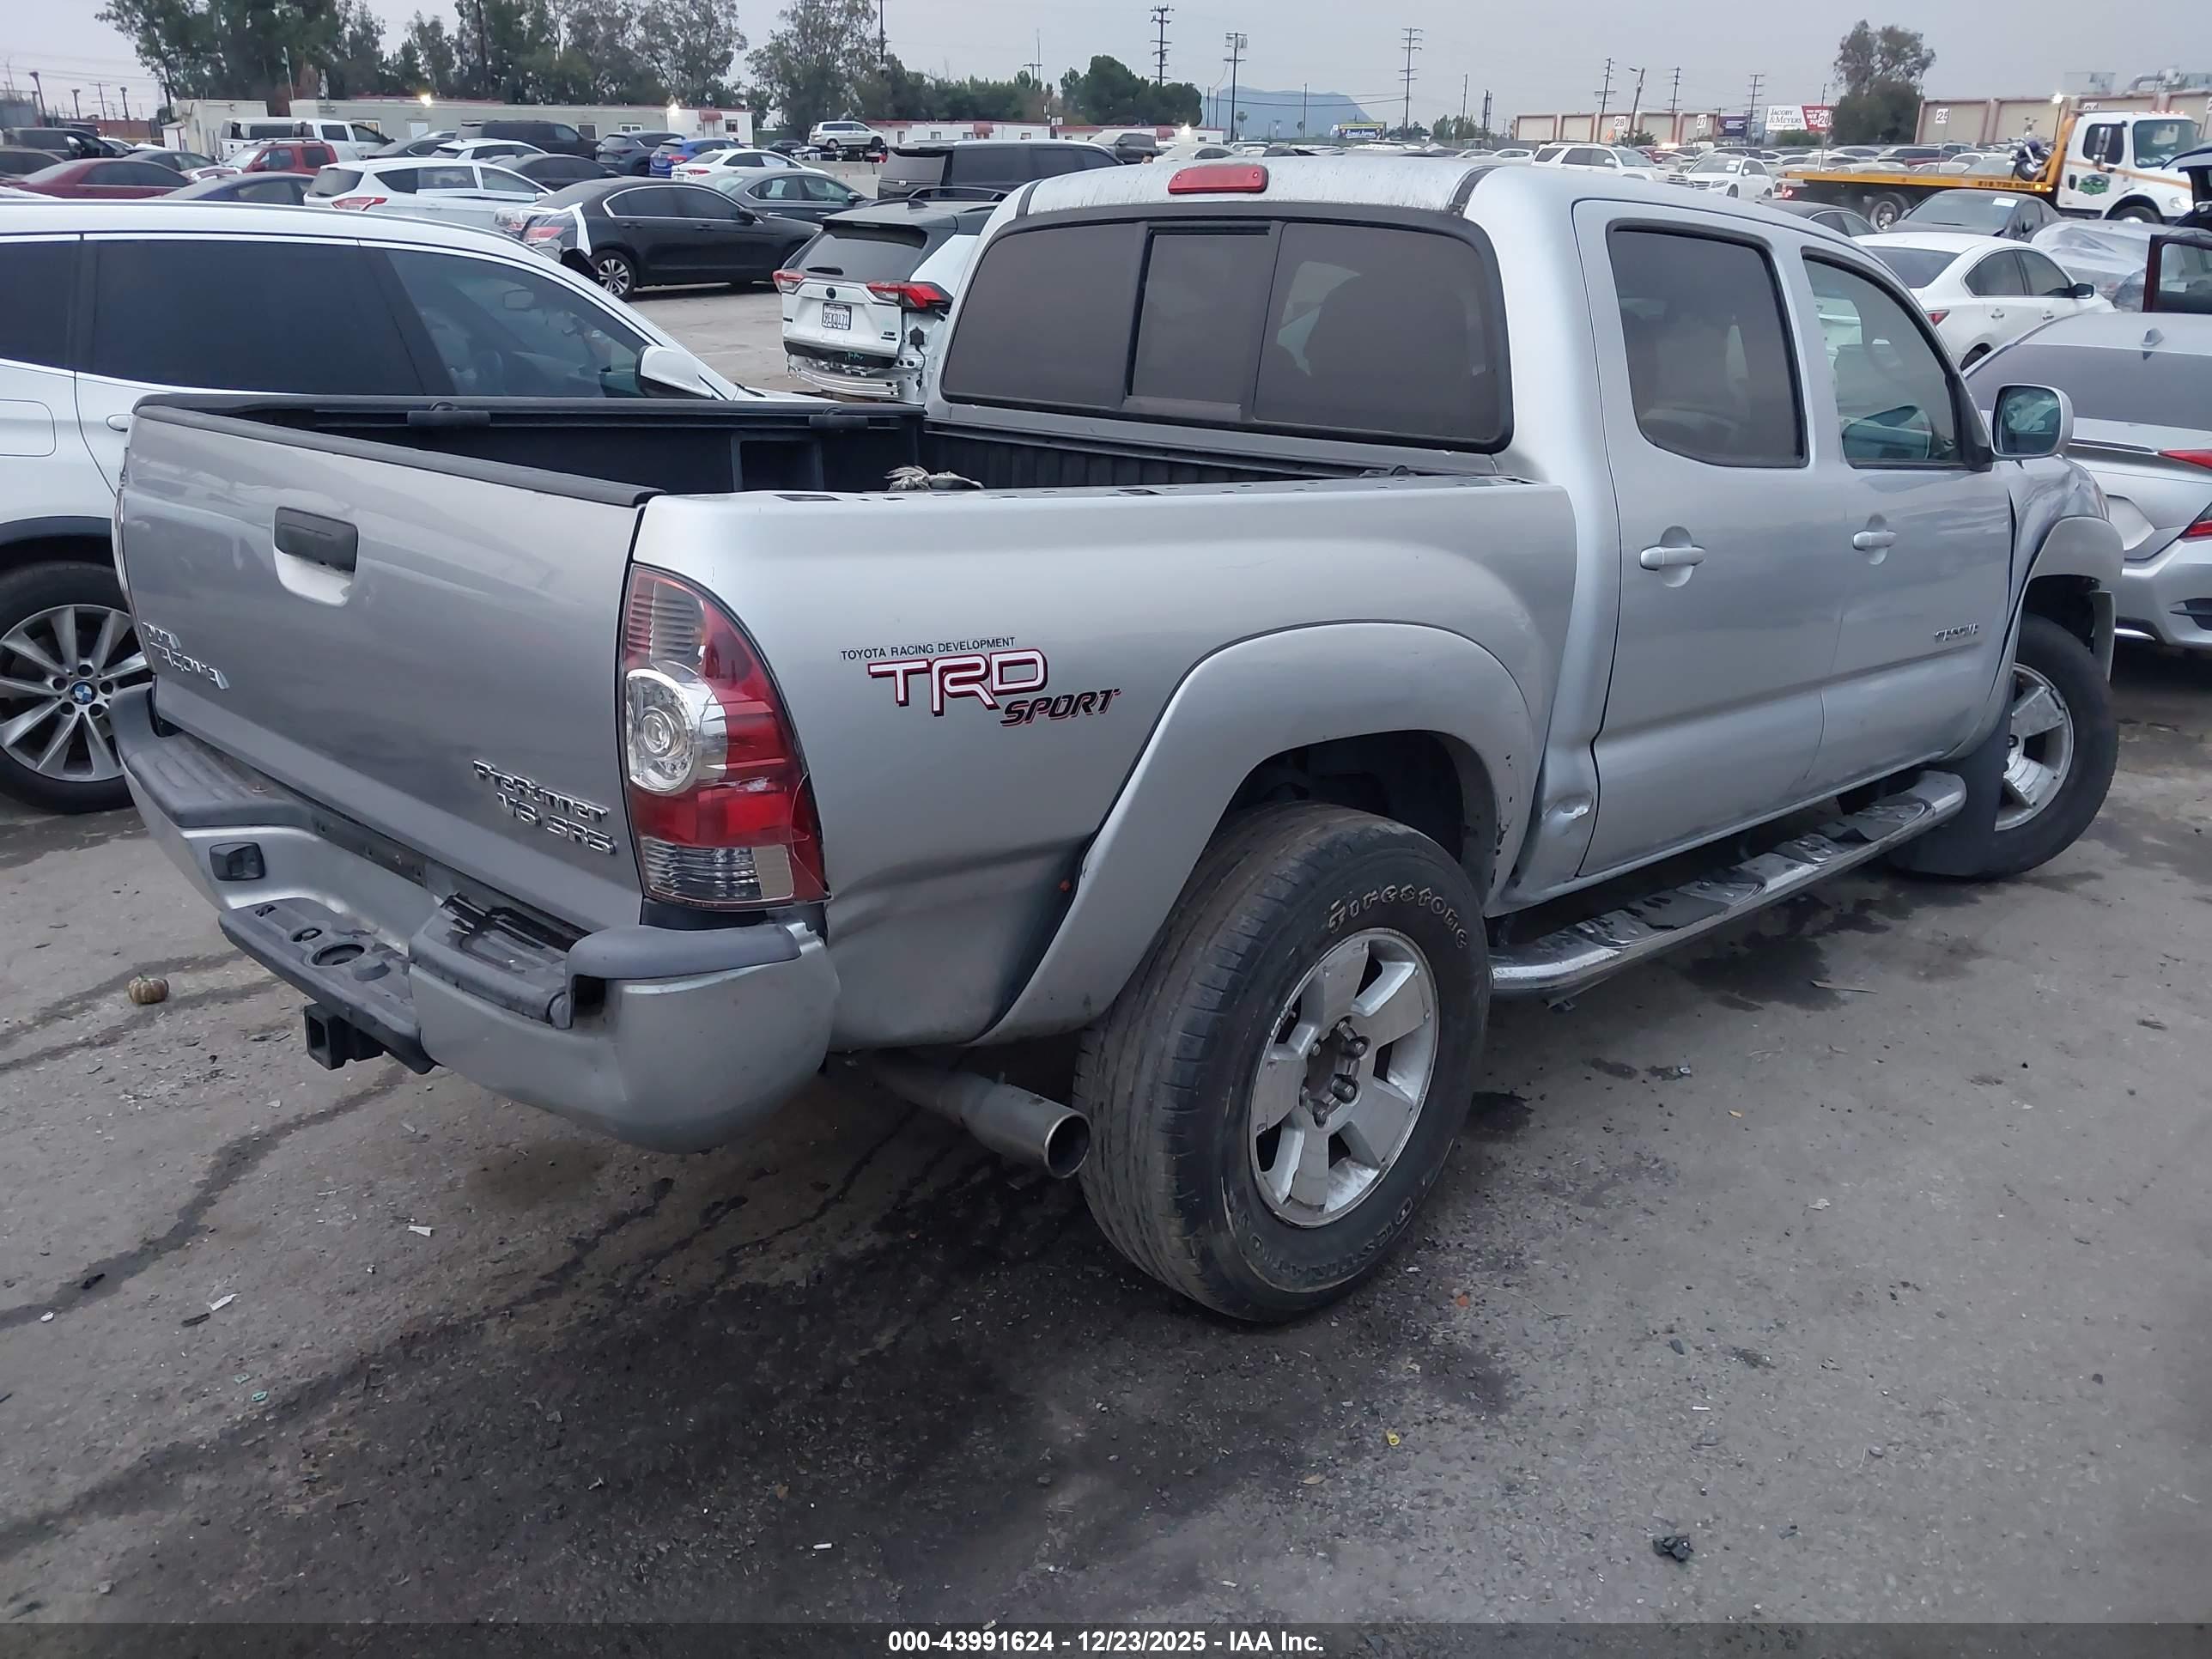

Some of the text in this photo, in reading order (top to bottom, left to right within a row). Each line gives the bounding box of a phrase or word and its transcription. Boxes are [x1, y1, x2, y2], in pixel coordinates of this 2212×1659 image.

[1615, 118, 1625, 127] 28
[1697, 117, 1706, 125] 27
[841, 636, 1016, 661] TOYOTA RACING DEVELOPMENT
[867, 648, 1048, 717] TRD
[1000, 688, 1121, 727] SPORT
[495, 792, 618, 855] V6 SR5
[1328, 884, 1468, 949] Firestone
